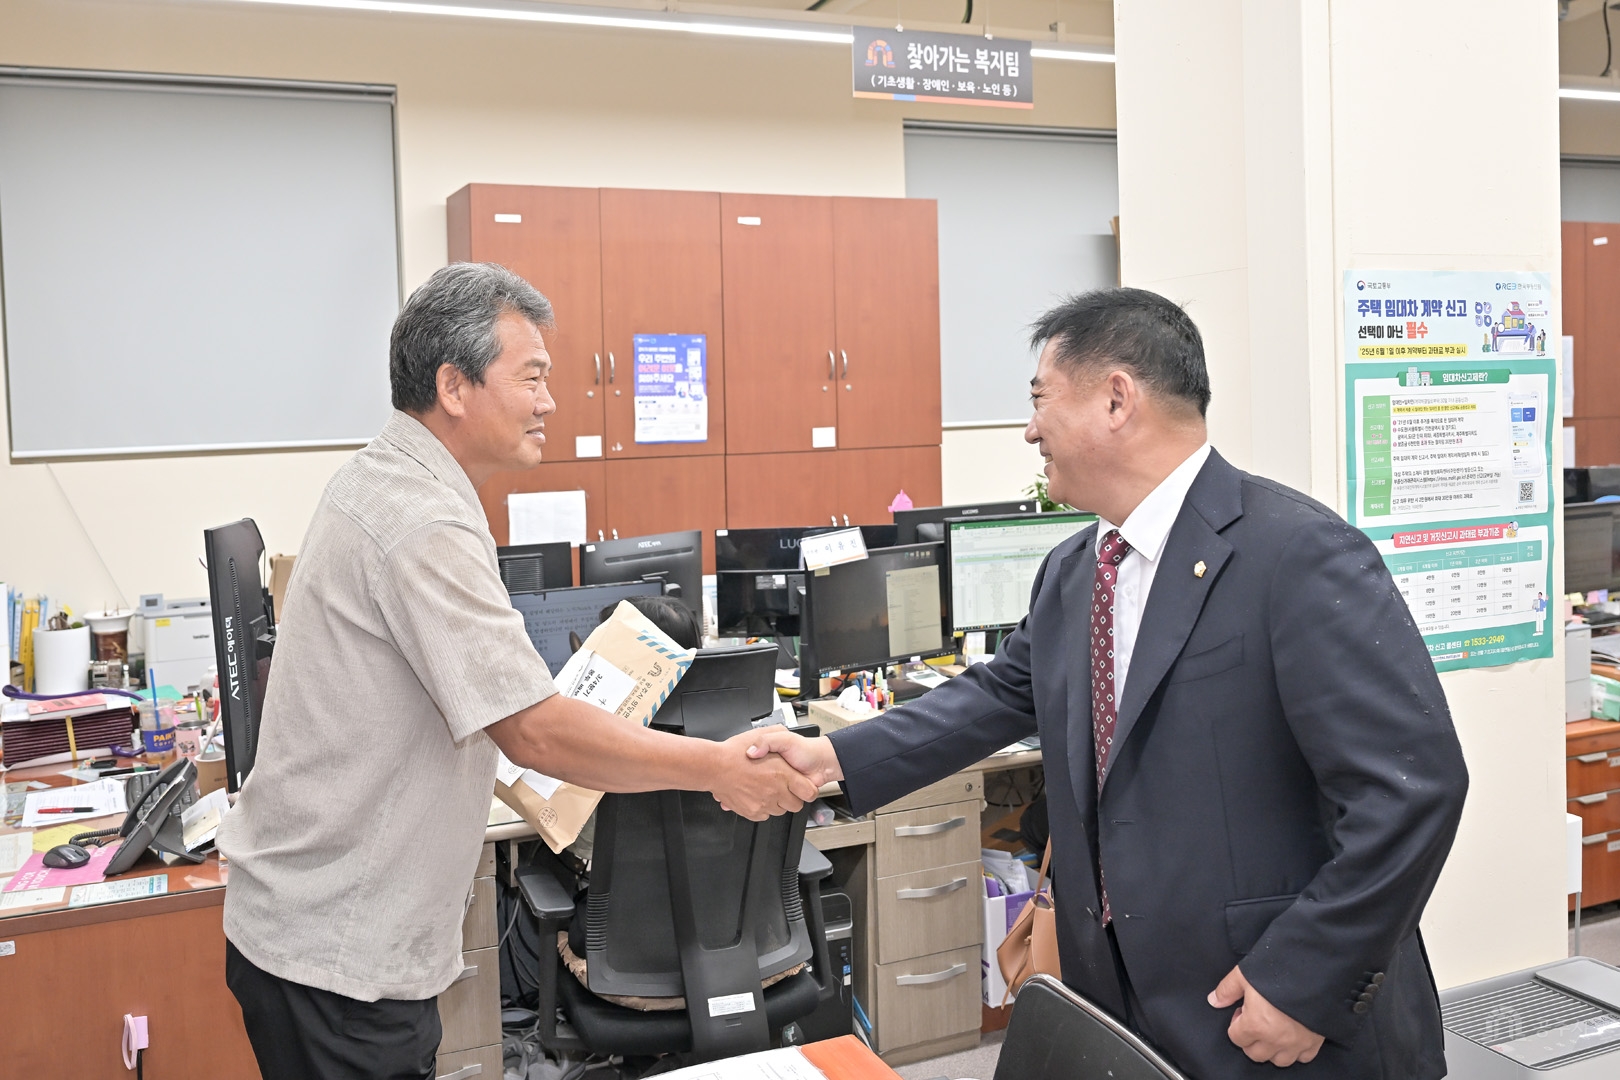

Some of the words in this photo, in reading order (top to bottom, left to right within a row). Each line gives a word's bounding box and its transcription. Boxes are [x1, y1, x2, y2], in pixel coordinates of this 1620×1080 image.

[907, 43, 970, 72] 찾아가는
[974, 48, 1019, 77] 복지팀
[922, 78, 950, 92] 장애인
[957, 82, 976, 94] 보육
[982, 83, 1000, 96] 노인
[1358, 300, 1382, 318] 주택
[1385, 299, 1418, 318] 임대차
[1421, 300, 1442, 318] 계약
[1446, 300, 1467, 317] 신고
[1358, 326, 1384, 338] 선택이
[1387, 326, 1403, 338] 아닌
[1406, 322, 1428, 339] 필수
[1376, 348, 1384, 356] 6월
[1400, 534, 1422, 544] 지연신고
[1478, 528, 1500, 538] 부과기준
[225, 616, 236, 652] 에이텍
[1435, 643, 1445, 651] 신고
[1446, 640, 1462, 650] 콜센터
[1472, 635, 1504, 646] 1533-2949
[228, 652, 240, 700] ATEC
[583, 674, 603, 698] 3/4분기
[636, 682, 652, 700] 공주시
[622, 700, 639, 718] 의당면
